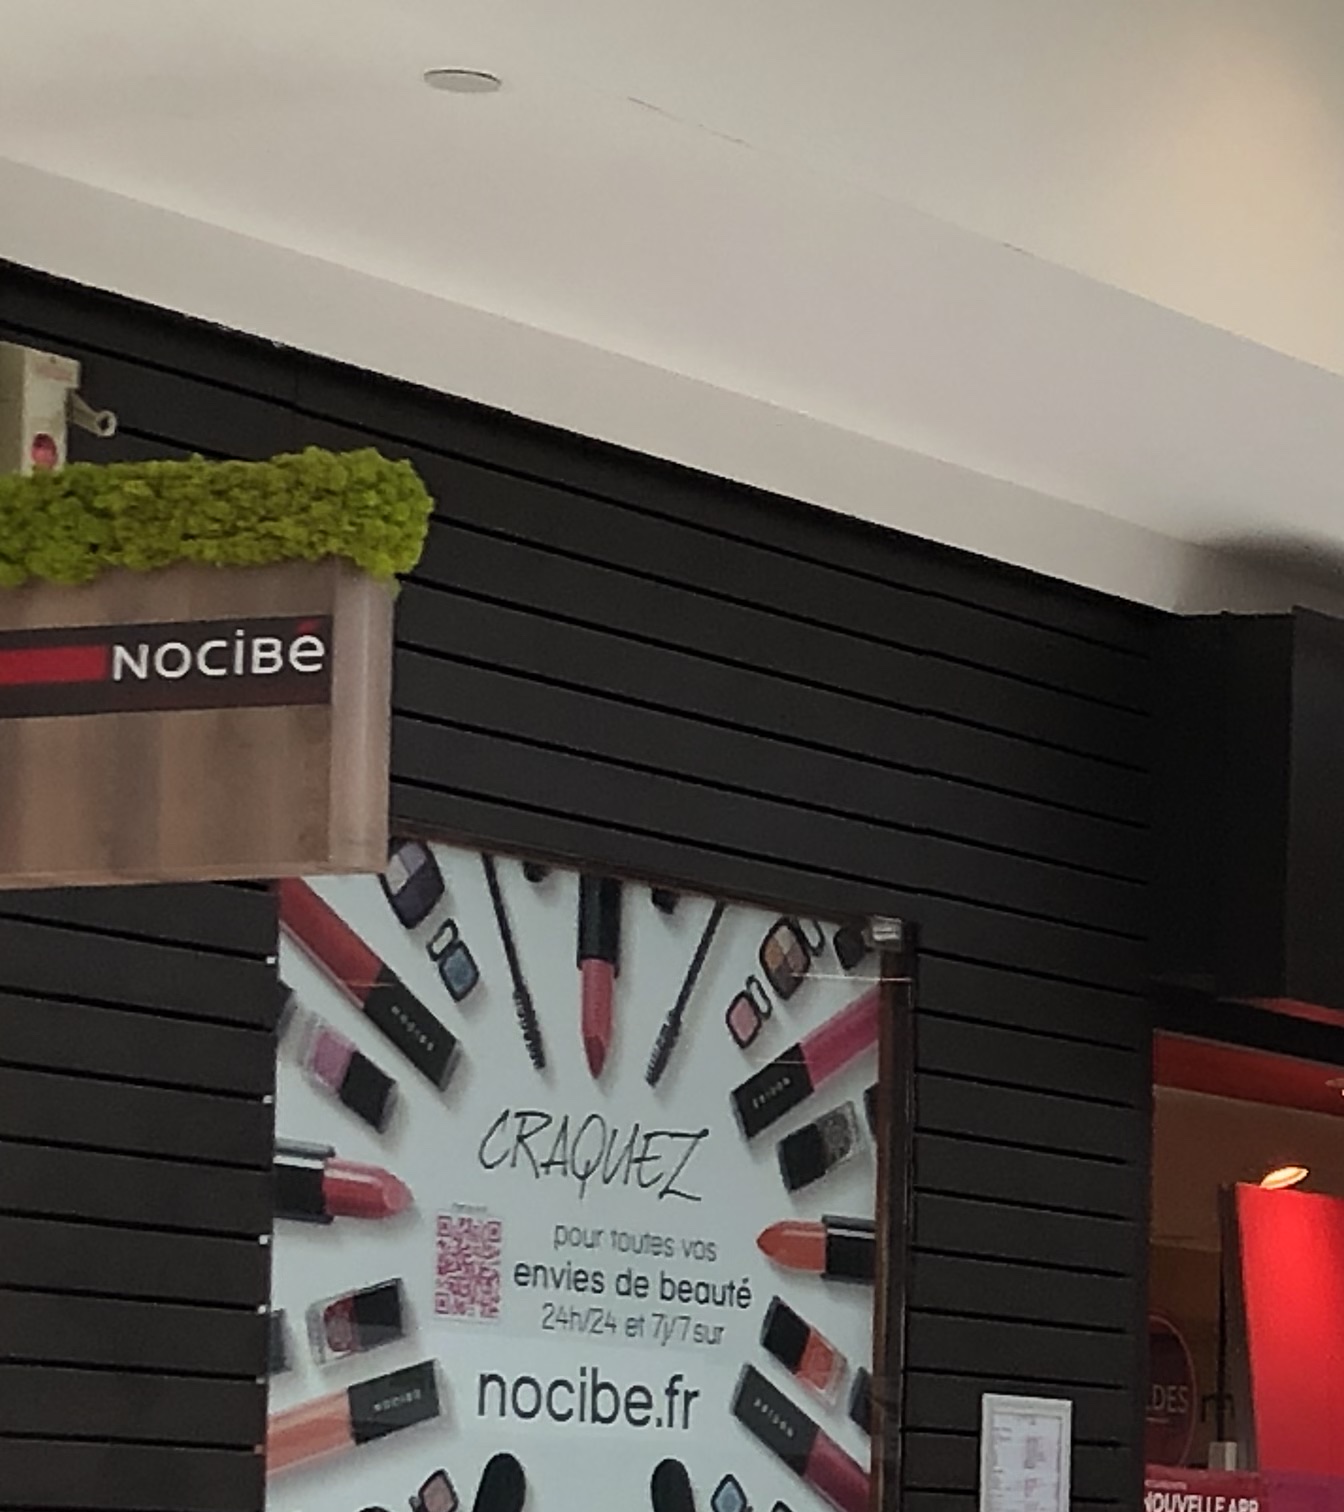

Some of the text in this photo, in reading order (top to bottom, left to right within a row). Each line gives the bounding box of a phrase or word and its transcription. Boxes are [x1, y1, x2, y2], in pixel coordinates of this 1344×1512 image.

[478, 1108, 710, 1202] CRAQUEZ
[553, 1223, 718, 1262] pour toutes vos
[513, 1260, 752, 1309] envies de beauté
[541, 1302, 618, 1337] 24h/24
[624, 1313, 645, 1338] et
[692, 1324, 726, 1346] sur
[477, 1366, 700, 1430] nocibe.fr
